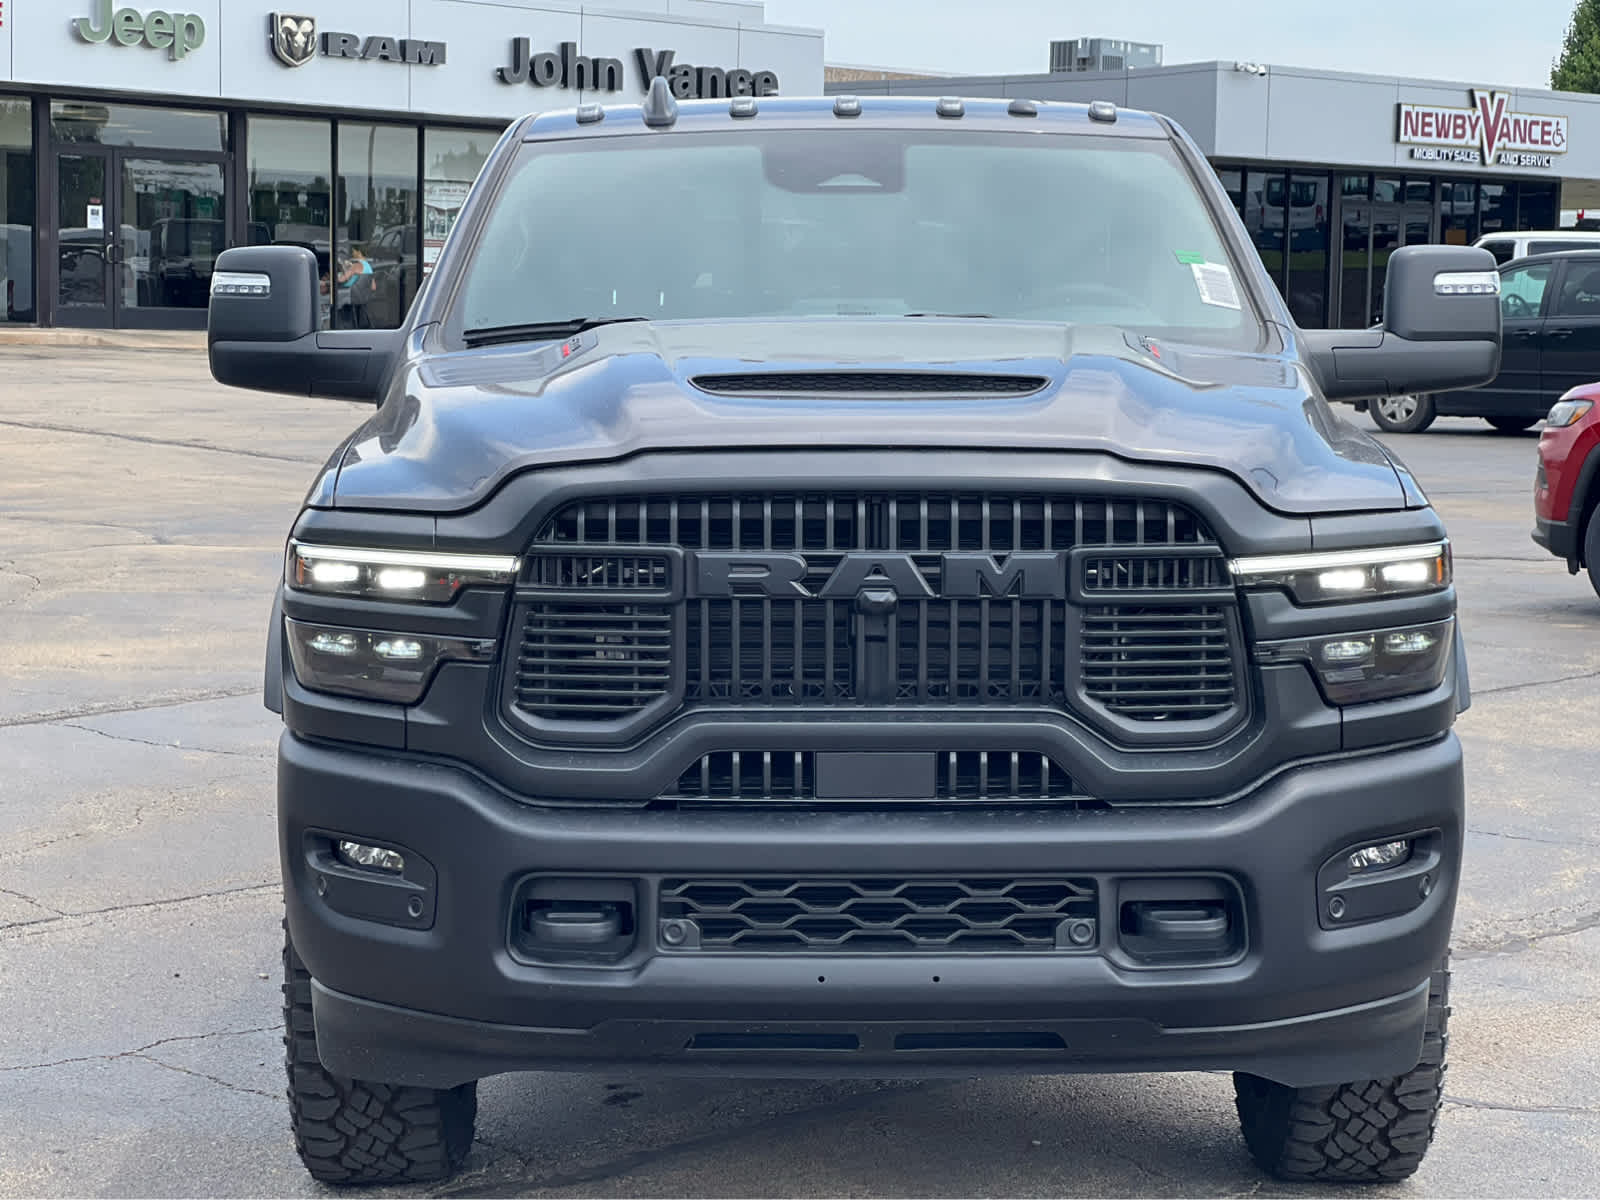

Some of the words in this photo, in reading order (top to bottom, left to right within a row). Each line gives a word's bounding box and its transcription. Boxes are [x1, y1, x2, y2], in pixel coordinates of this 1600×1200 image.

[71, 0, 206, 61] Jeep
[320, 31, 448, 65] RAM
[497, 37, 624, 92] John
[632, 48, 780, 99] Vance
[1403, 111, 1481, 141] NEWBY
[1477, 94, 1553, 154] VANCE
[1413, 148, 1453, 161] MOBILITY
[1454, 150, 1480, 163] SALES
[1499, 153, 1519, 166] AND
[690, 551, 1063, 600] RAM
